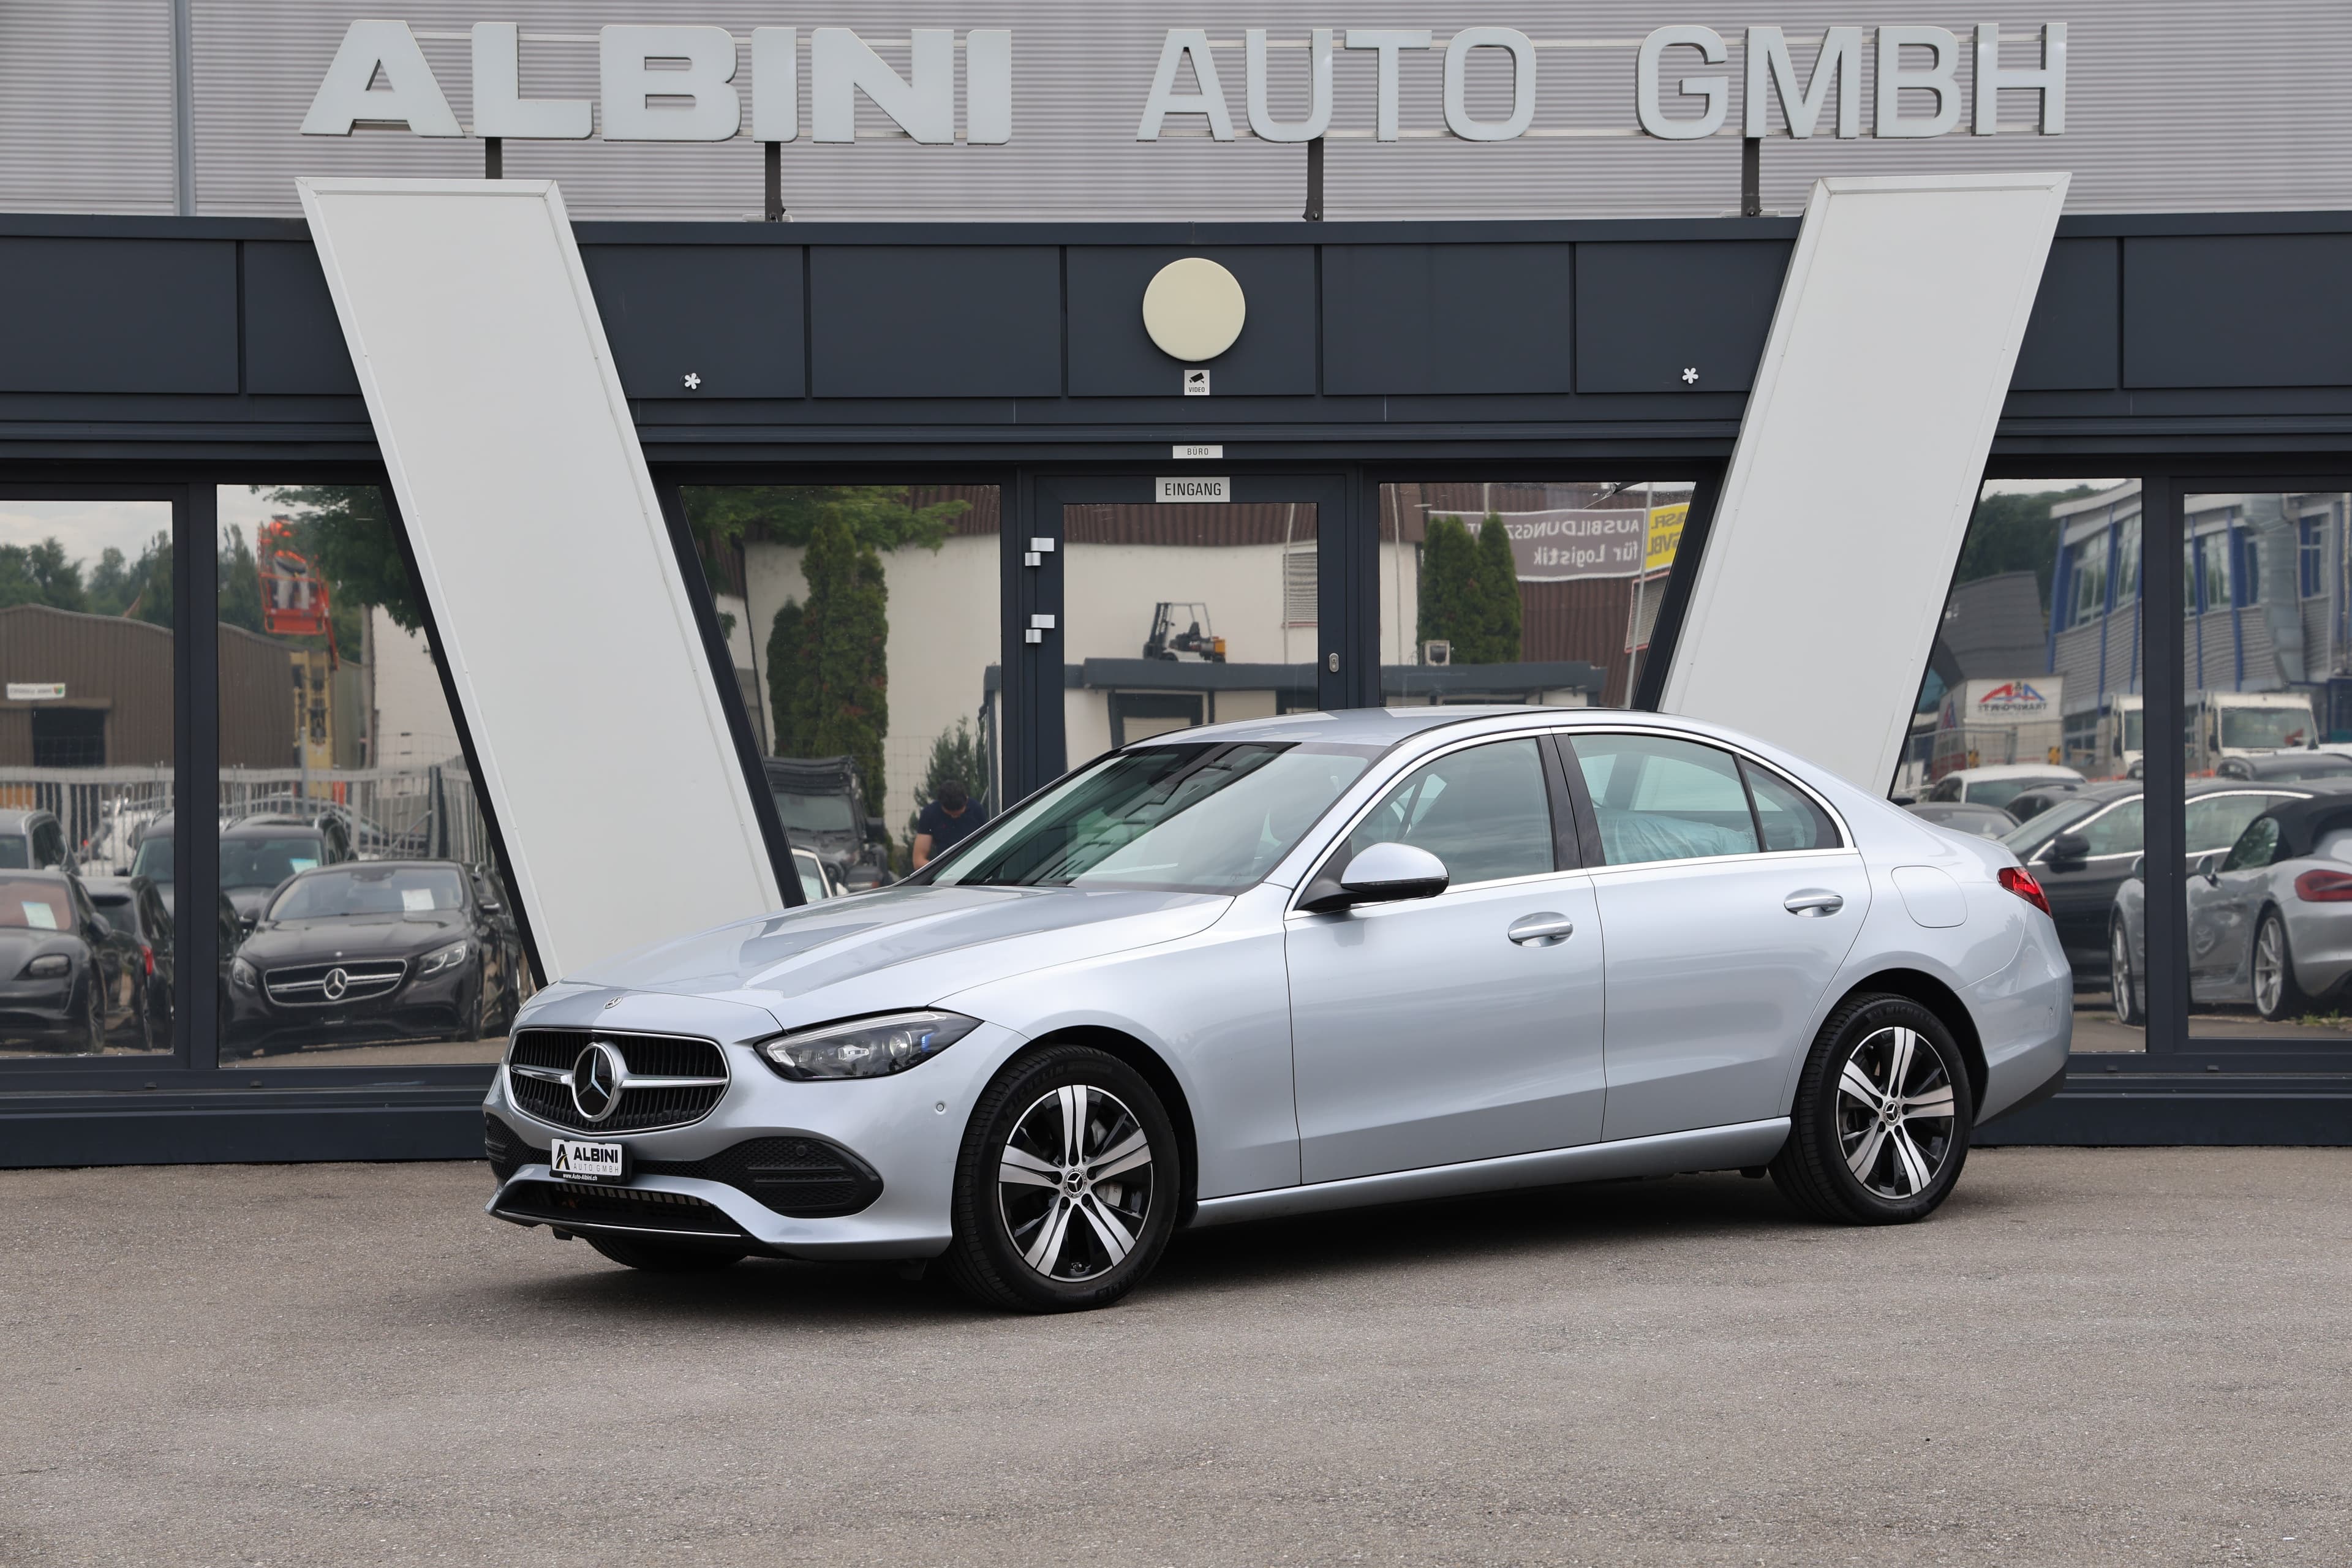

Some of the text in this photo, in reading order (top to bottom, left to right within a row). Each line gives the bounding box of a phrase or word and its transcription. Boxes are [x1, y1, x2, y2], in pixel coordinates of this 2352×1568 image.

[298, 18, 2068, 145] ALBINI AUTO GMBH
[1165, 483, 1221, 496] EINGANG
[573, 1147, 618, 1163] ALBINI
[573, 1163, 619, 1174] AUTO GMBH
[563, 1173, 598, 1182] www.Auto-Albini.ch
